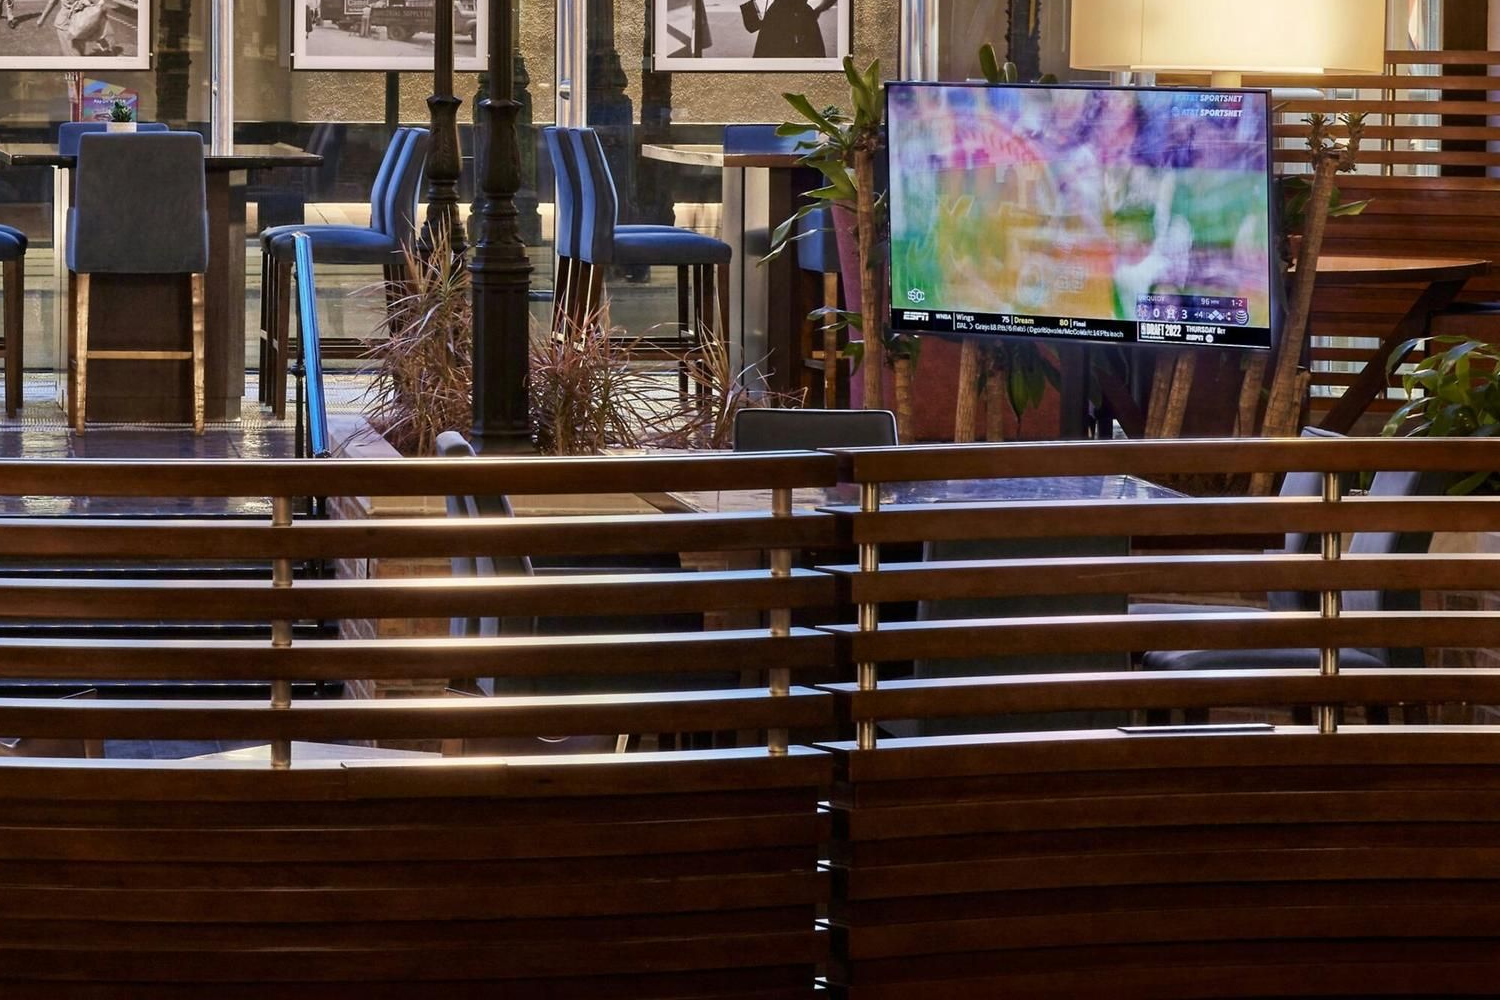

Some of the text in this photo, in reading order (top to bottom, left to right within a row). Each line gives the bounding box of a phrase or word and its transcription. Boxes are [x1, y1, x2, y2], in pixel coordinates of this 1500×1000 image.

[1200, 94, 1242, 103] SPORTSNET
[1200, 109, 1242, 117] SPORTSNET
[1231, 299, 1243, 307] 1-2
[903, 311, 929, 321] ESPN
[956, 314, 974, 322] Wings
[1014, 317, 1034, 325] Dream
[1153, 308, 1160, 318] 0
[1181, 309, 1188, 319] 3
[1147, 323, 1164, 336] DRAFT
[1165, 324, 1181, 337] 2022
[1186, 325, 1215, 334] THURSDAY
